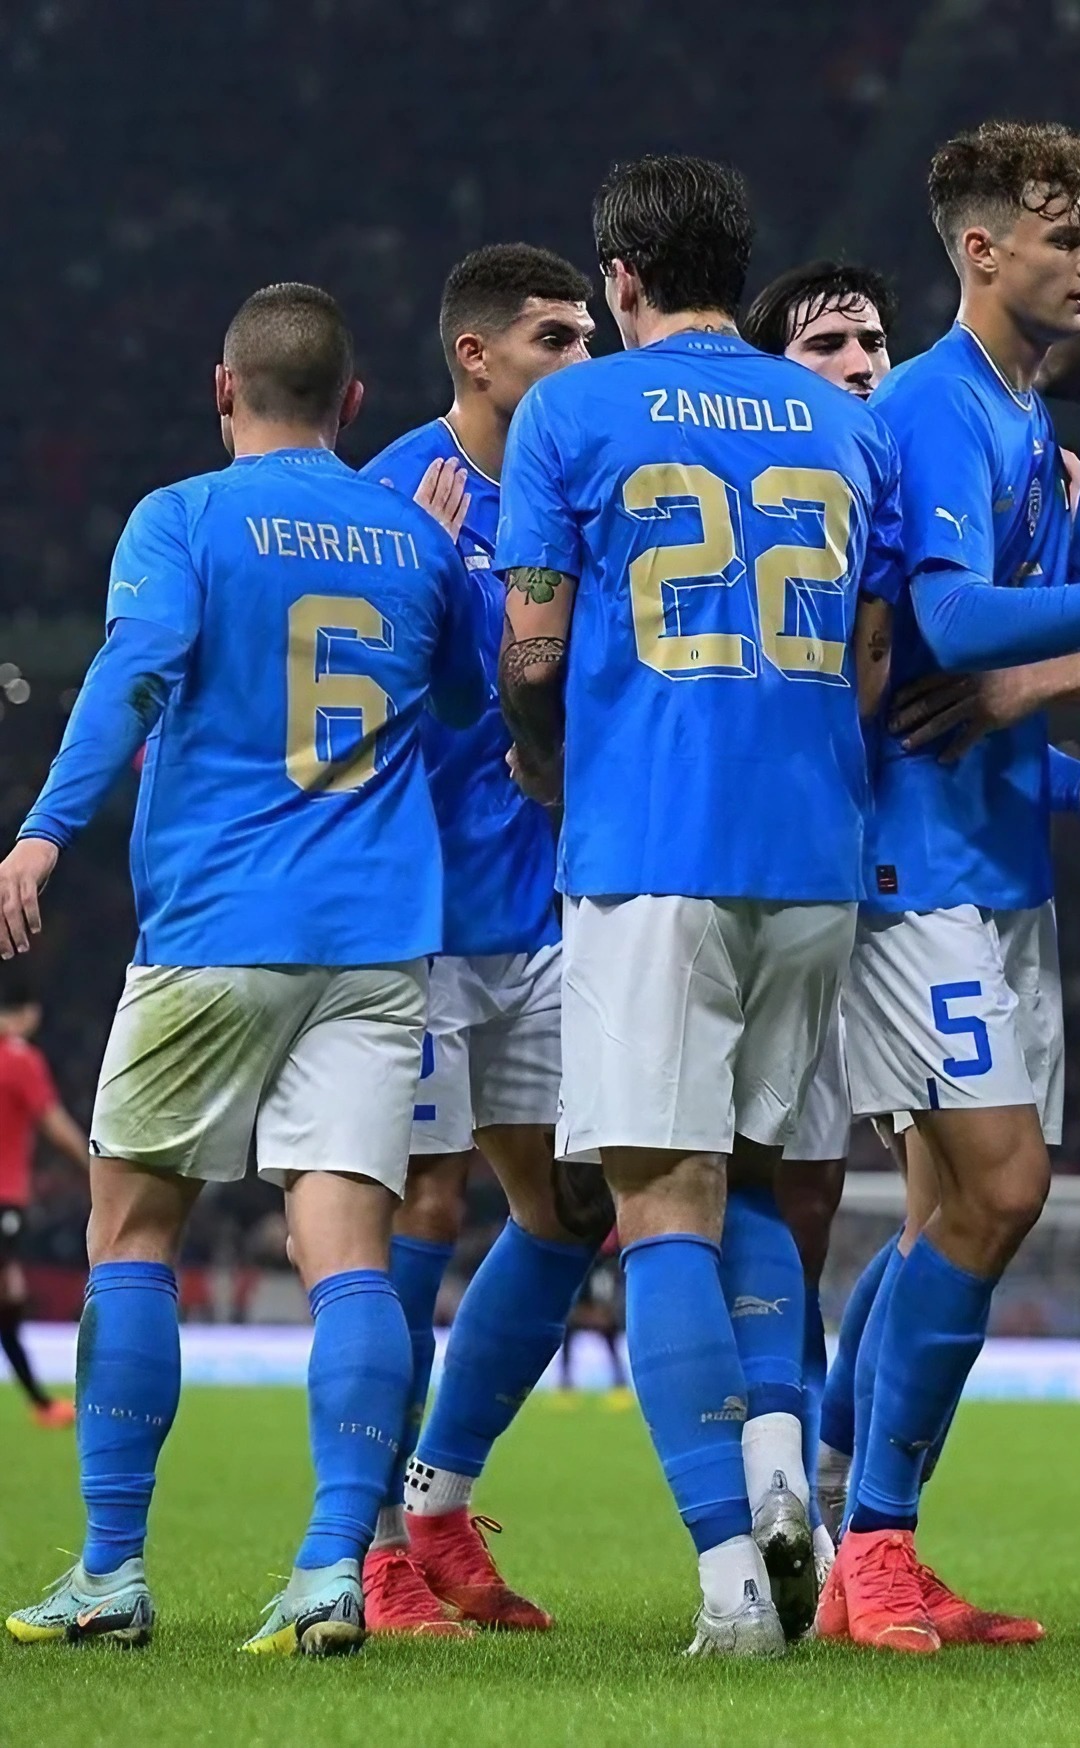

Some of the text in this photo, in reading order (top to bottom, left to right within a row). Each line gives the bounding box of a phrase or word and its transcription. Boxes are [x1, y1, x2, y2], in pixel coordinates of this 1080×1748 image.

[643, 388, 813, 432] ZANIOLO
[245, 516, 420, 569] VERRATTI
[623, 463, 850, 687] 22
[286, 594, 399, 801] 6
[930, 981, 993, 1078] 5
